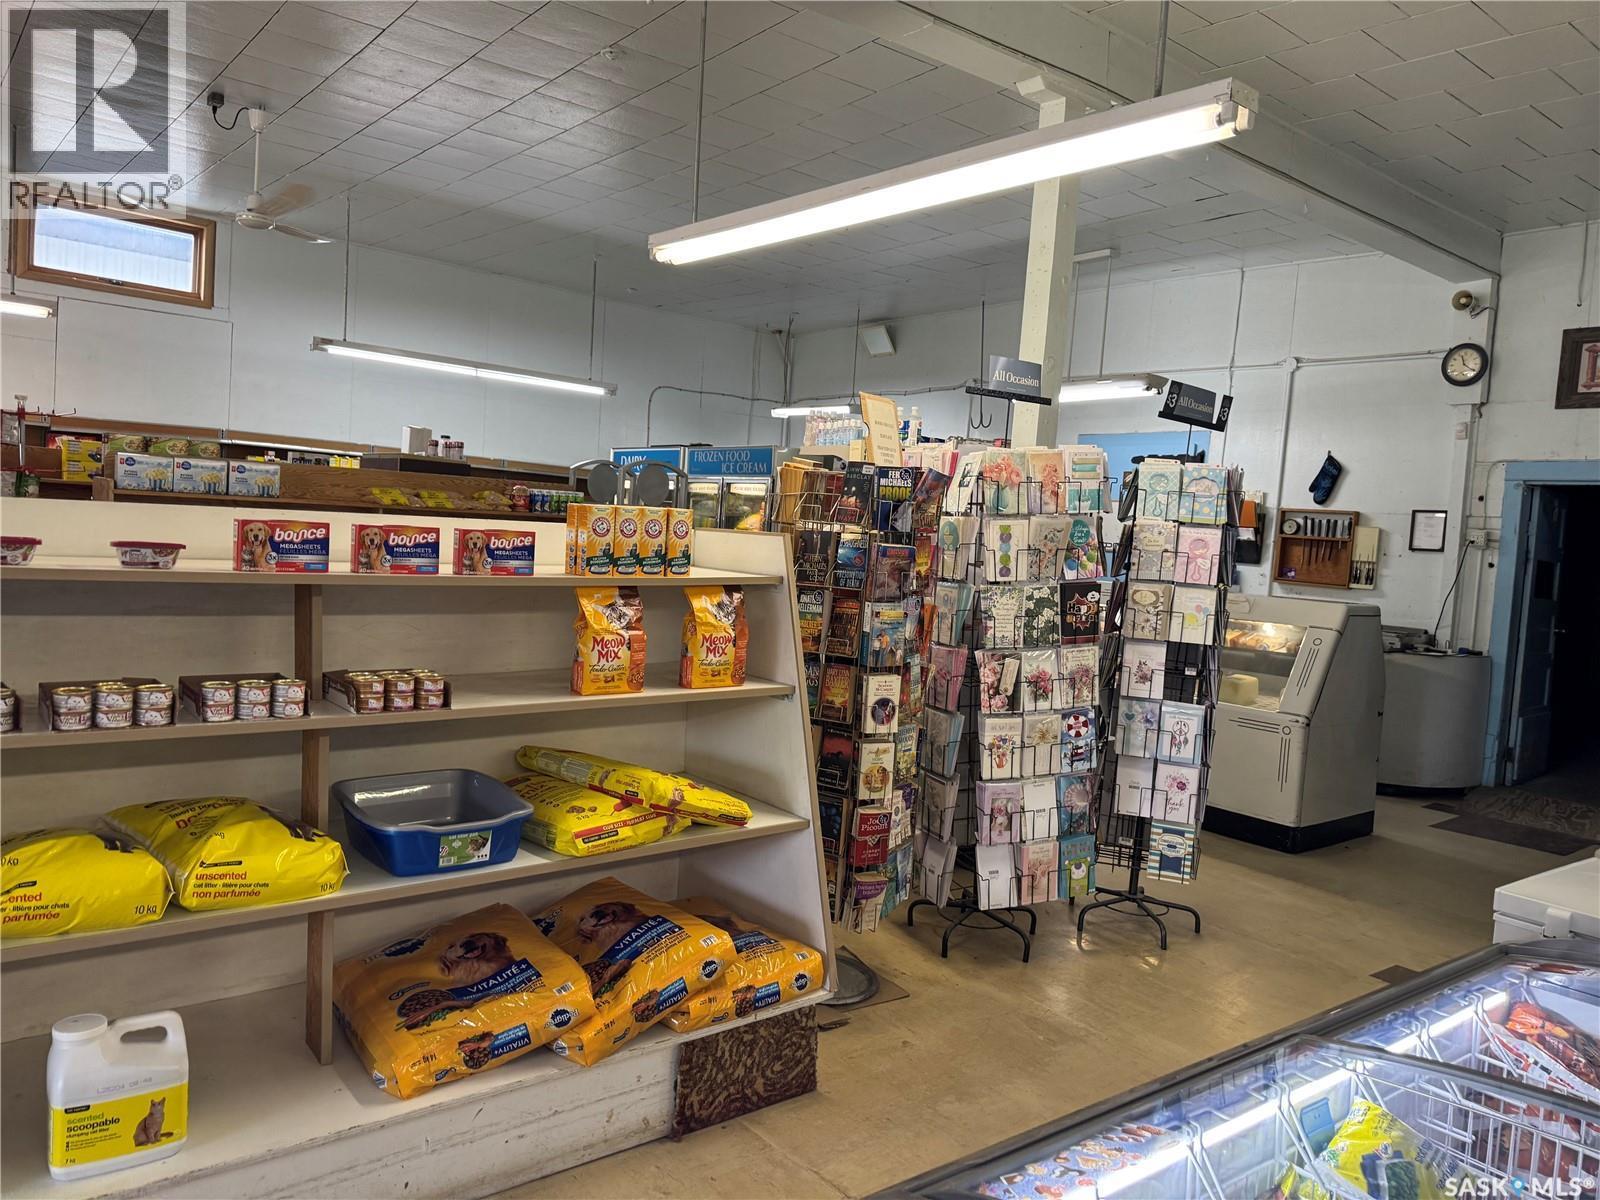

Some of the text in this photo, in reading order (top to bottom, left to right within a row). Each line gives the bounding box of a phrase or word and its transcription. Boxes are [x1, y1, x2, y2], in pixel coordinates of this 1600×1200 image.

[992, 370, 1040, 388] All Occasion
[1177, 396, 1213, 414] All Occasion
[694, 449, 750, 462] FROZEN FOOD
[721, 461, 768, 474] ICE CREAM
[879, 478, 912, 487] MICHAELS
[879, 486, 912, 501] PROOF
[274, 527, 326, 544] bounce
[389, 532, 437, 547] bounce
[490, 536, 533, 550] bounce
[591, 632, 626, 652] Meow
[700, 633, 733, 649] Meow
[194, 870, 248, 881] unscented
[238, 882, 253, 890] pour
[192, 889, 261, 900] non parfumée
[134, 905, 146, 915] 10
[66, 1112, 105, 1125] scented
[66, 1116, 120, 1134] scoopable
